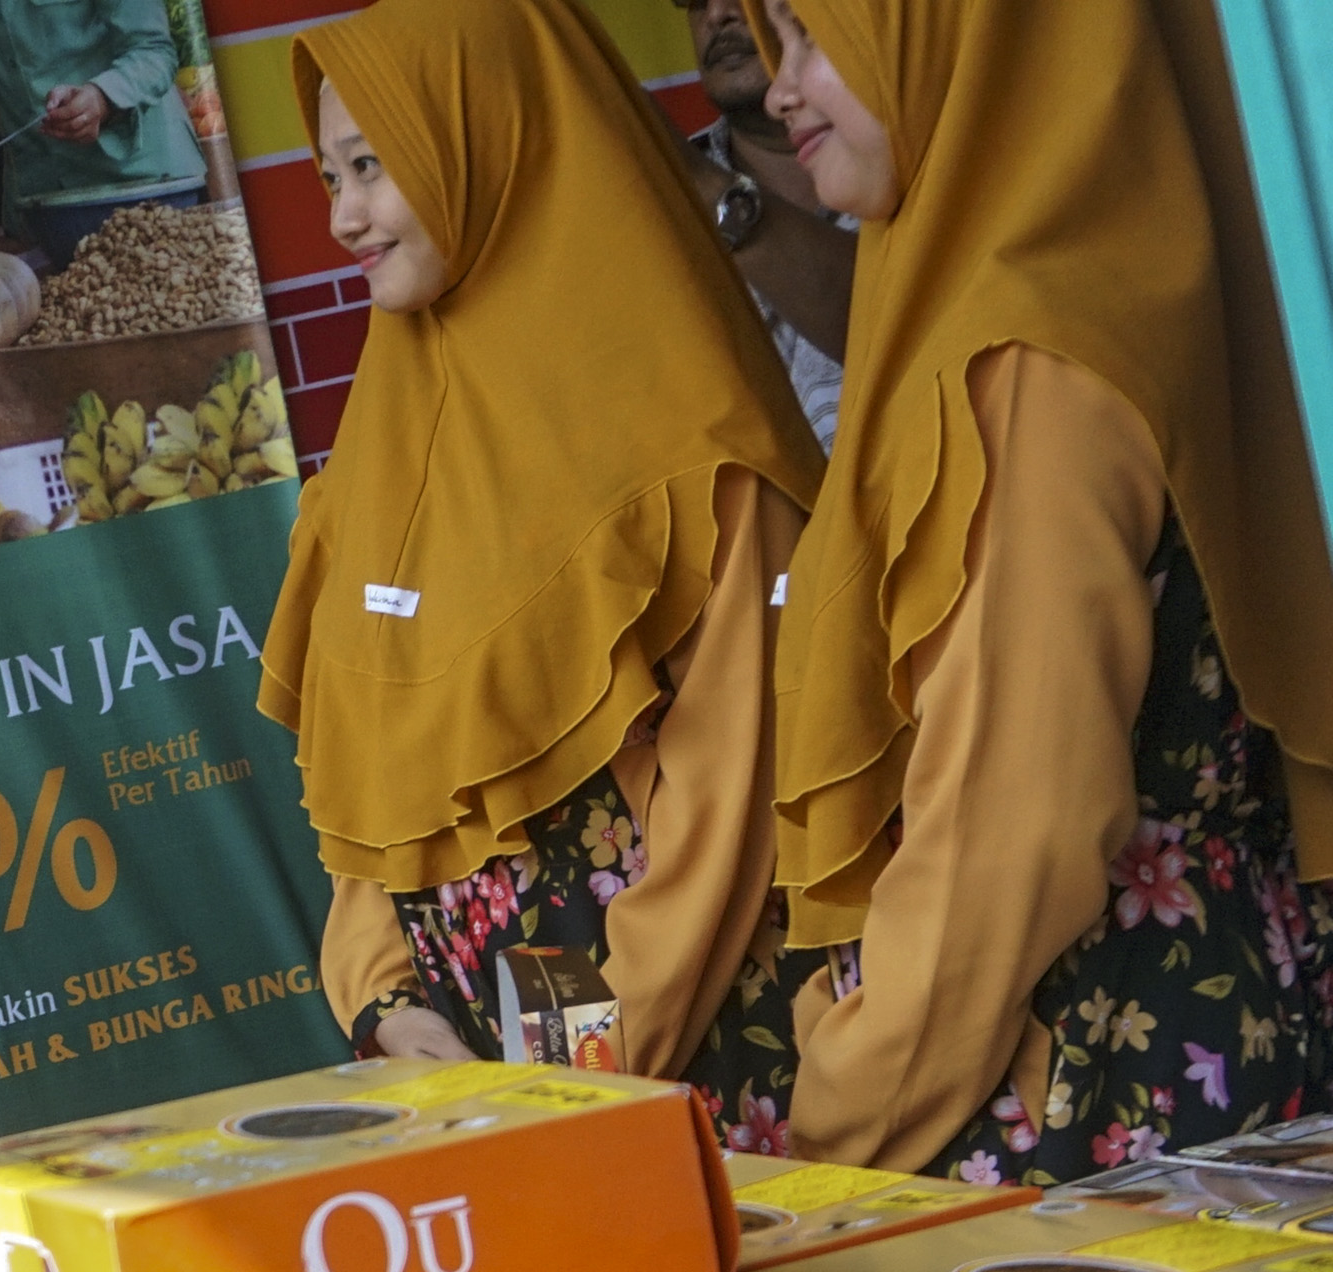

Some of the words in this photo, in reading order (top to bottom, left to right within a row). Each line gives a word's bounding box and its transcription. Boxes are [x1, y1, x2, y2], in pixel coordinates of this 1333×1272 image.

[88, 605, 263, 715] JASA
[101, 728, 201, 779] Efektif
[108, 781, 155, 811] Per
[162, 756, 254, 796] Tahun
[63, 945, 199, 1007] SUKSES
[46, 1033, 80, 1064] &
[87, 993, 216, 1053] BUNGA
